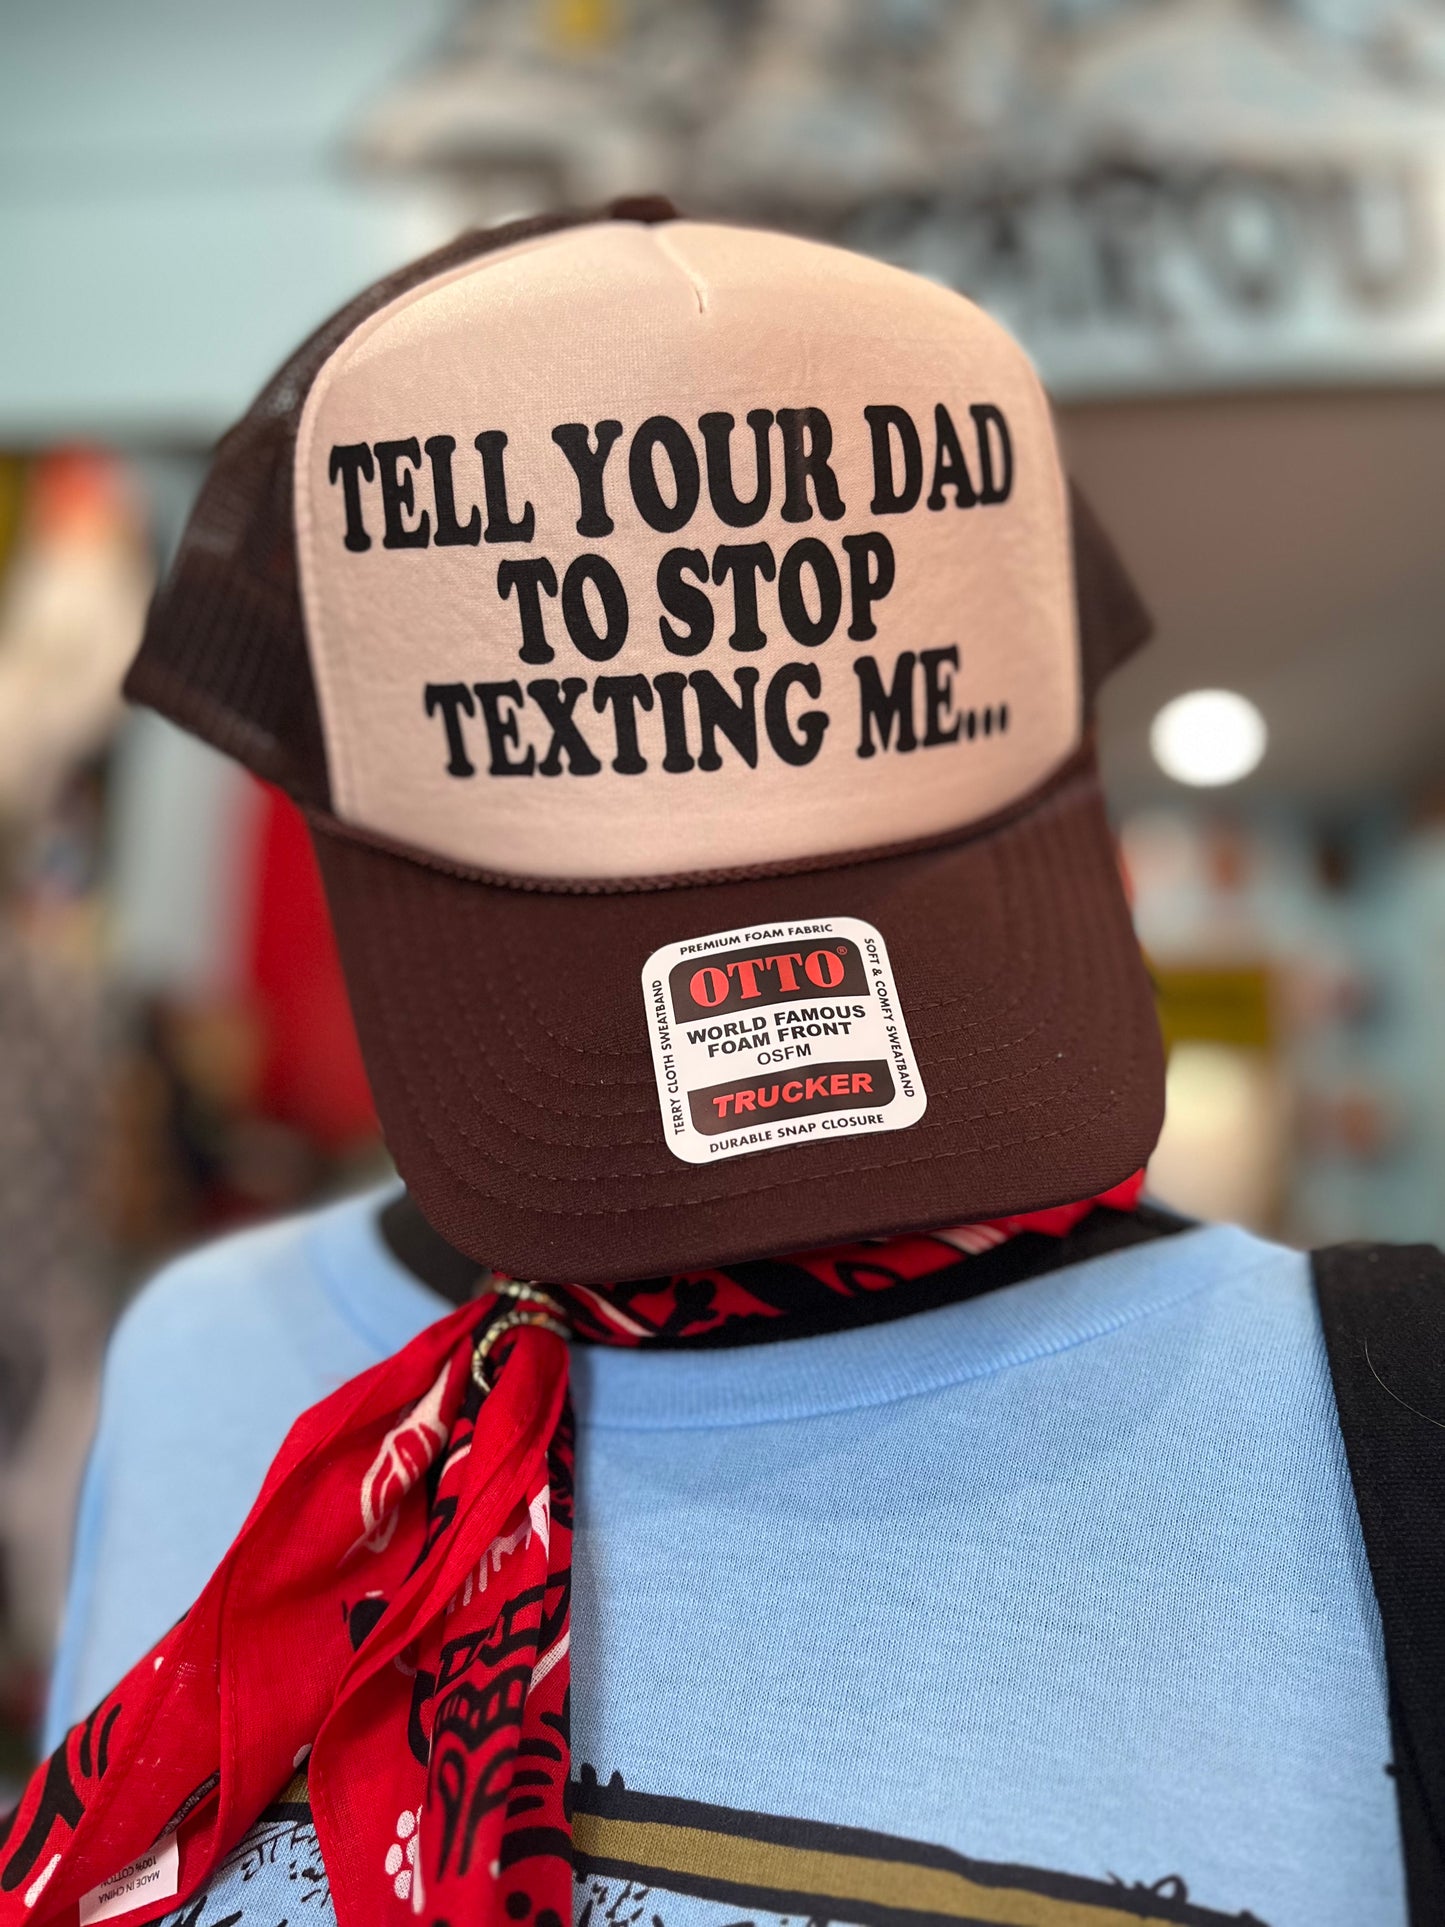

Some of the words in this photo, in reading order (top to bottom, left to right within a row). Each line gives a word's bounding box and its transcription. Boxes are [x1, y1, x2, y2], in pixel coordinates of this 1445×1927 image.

[329, 430, 535, 552] TELL
[551, 407, 846, 538] YOUR
[864, 403, 1015, 515] DAD
[497, 553, 629, 665] TO
[656, 531, 895, 657] STOP
[424, 662, 830, 778] TEXTING
[853, 643, 1009, 759] ME...
[679, 935, 741, 956] PREMIUM
[745, 927, 784, 942] FOAM
[788, 923, 833, 937] FABRIC
[864, 937, 879, 965] SOFT
[872, 967, 882, 977] &
[652, 979, 672, 1050] SWEATBAND
[875, 980, 894, 1022] COMFY
[686, 1016, 767, 1044] WORLD
[774, 1004, 866, 1027] FAMOUS
[708, 1032, 771, 1058] FOAM
[778, 1021, 852, 1043] FRONT
[664, 1053, 679, 1094] CLOTH
[757, 1043, 812, 1065] OSFM
[886, 1025, 914, 1098] SWEATBAND
[712, 1072, 874, 1118] TRUCKER
[671, 1097, 685, 1135] TERRY
[709, 1130, 773, 1153] DURABLE
[777, 1122, 817, 1139] SNAP
[821, 1113, 885, 1131] CLOSURE
[135, 1855, 157, 1872] 100%
[136, 1870, 161, 1887] MADE
[98, 1886, 125, 1904] CHINA
[126, 1881, 135, 1892] IN
